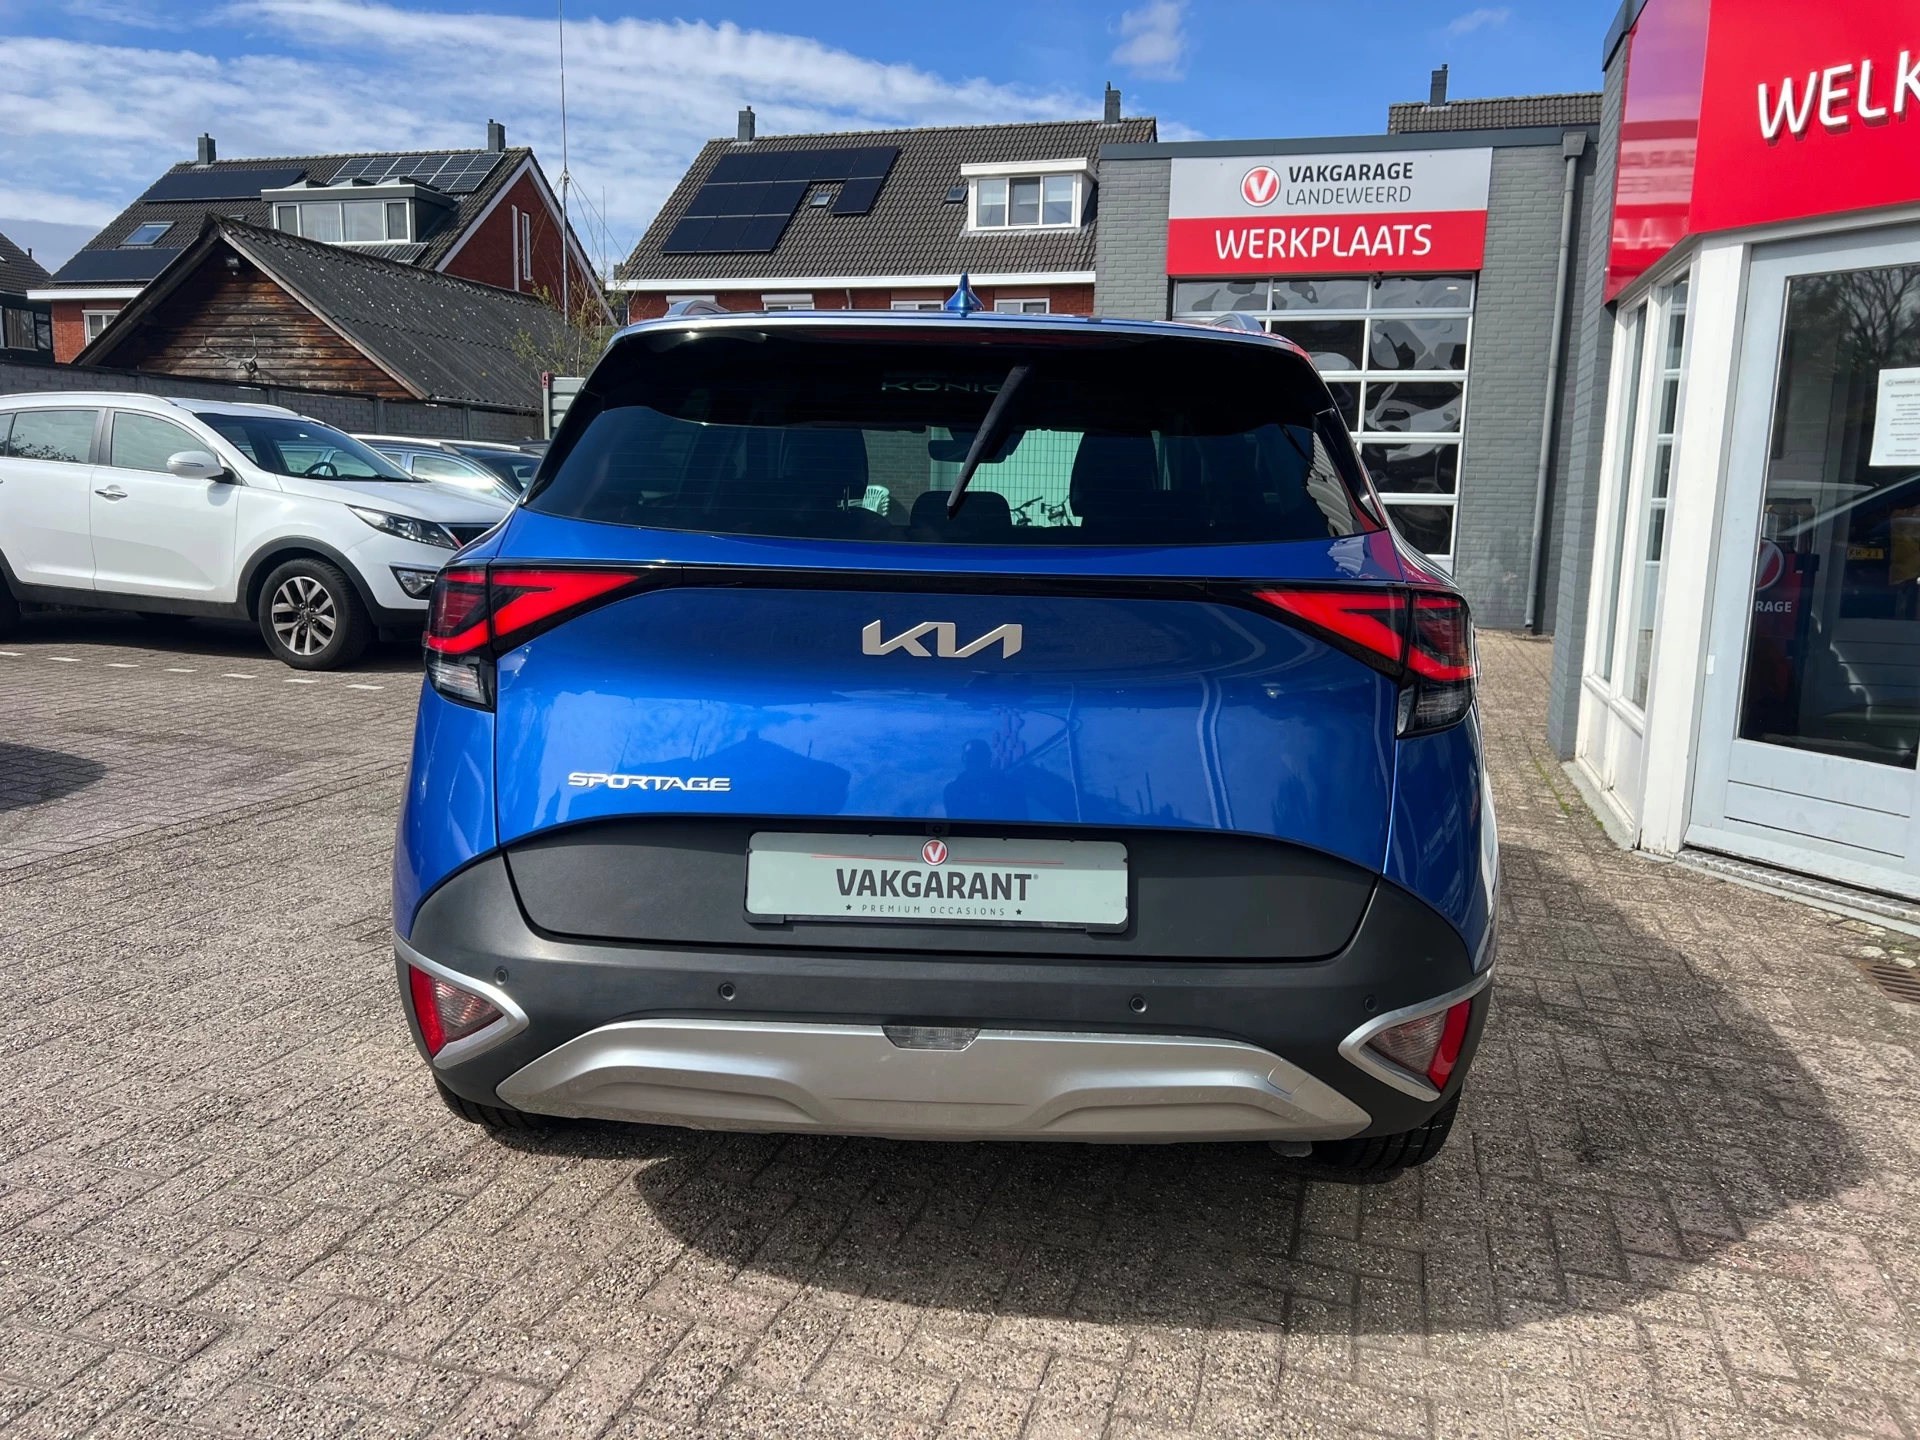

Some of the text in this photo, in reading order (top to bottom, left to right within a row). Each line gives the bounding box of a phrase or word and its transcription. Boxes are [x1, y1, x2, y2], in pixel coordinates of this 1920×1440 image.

[1757, 50, 1920, 138] WELK
[1288, 162, 1414, 183] VAKGARAGE
[1286, 185, 1412, 206] LANDEWEERD
[1215, 223, 1432, 260] WERKPLAATS
[1754, 600, 1793, 613] RAGE
[862, 619, 1023, 659] KIA
[568, 771, 732, 792] SPORTAGE
[861, 904, 1006, 916] PREMIUM OCCASIONS
